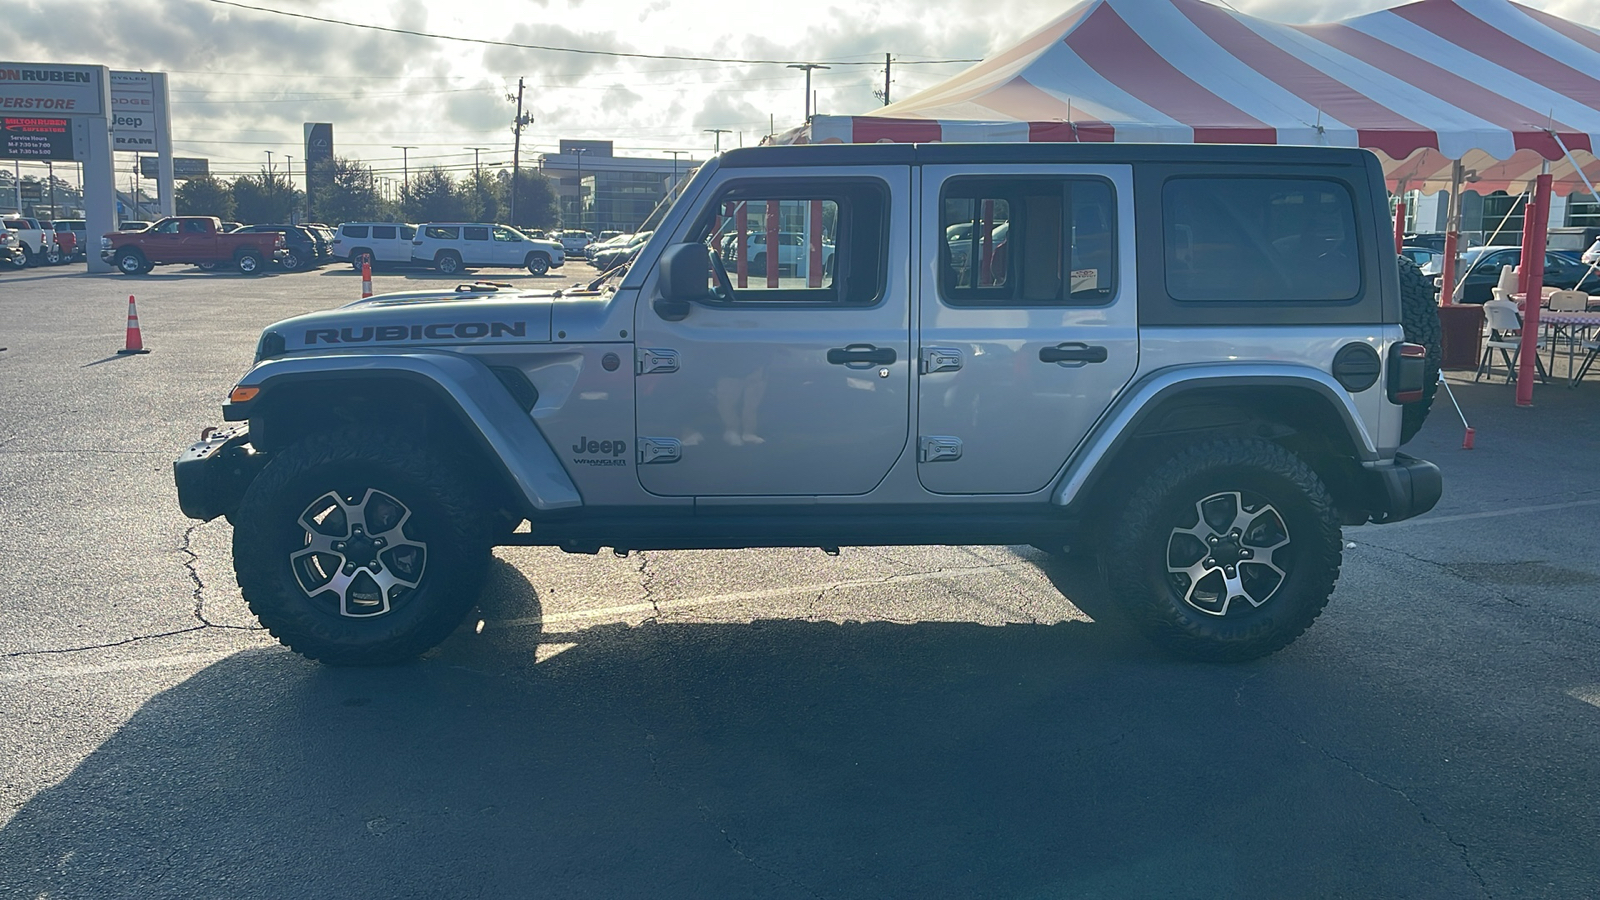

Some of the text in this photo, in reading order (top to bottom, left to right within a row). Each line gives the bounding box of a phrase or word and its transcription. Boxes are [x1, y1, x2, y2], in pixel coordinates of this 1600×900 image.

[22, 70, 91, 82] RUBEN
[112, 114, 143, 128] Jeep
[304, 321, 526, 345] RUBICON
[572, 436, 627, 457] Jeep
